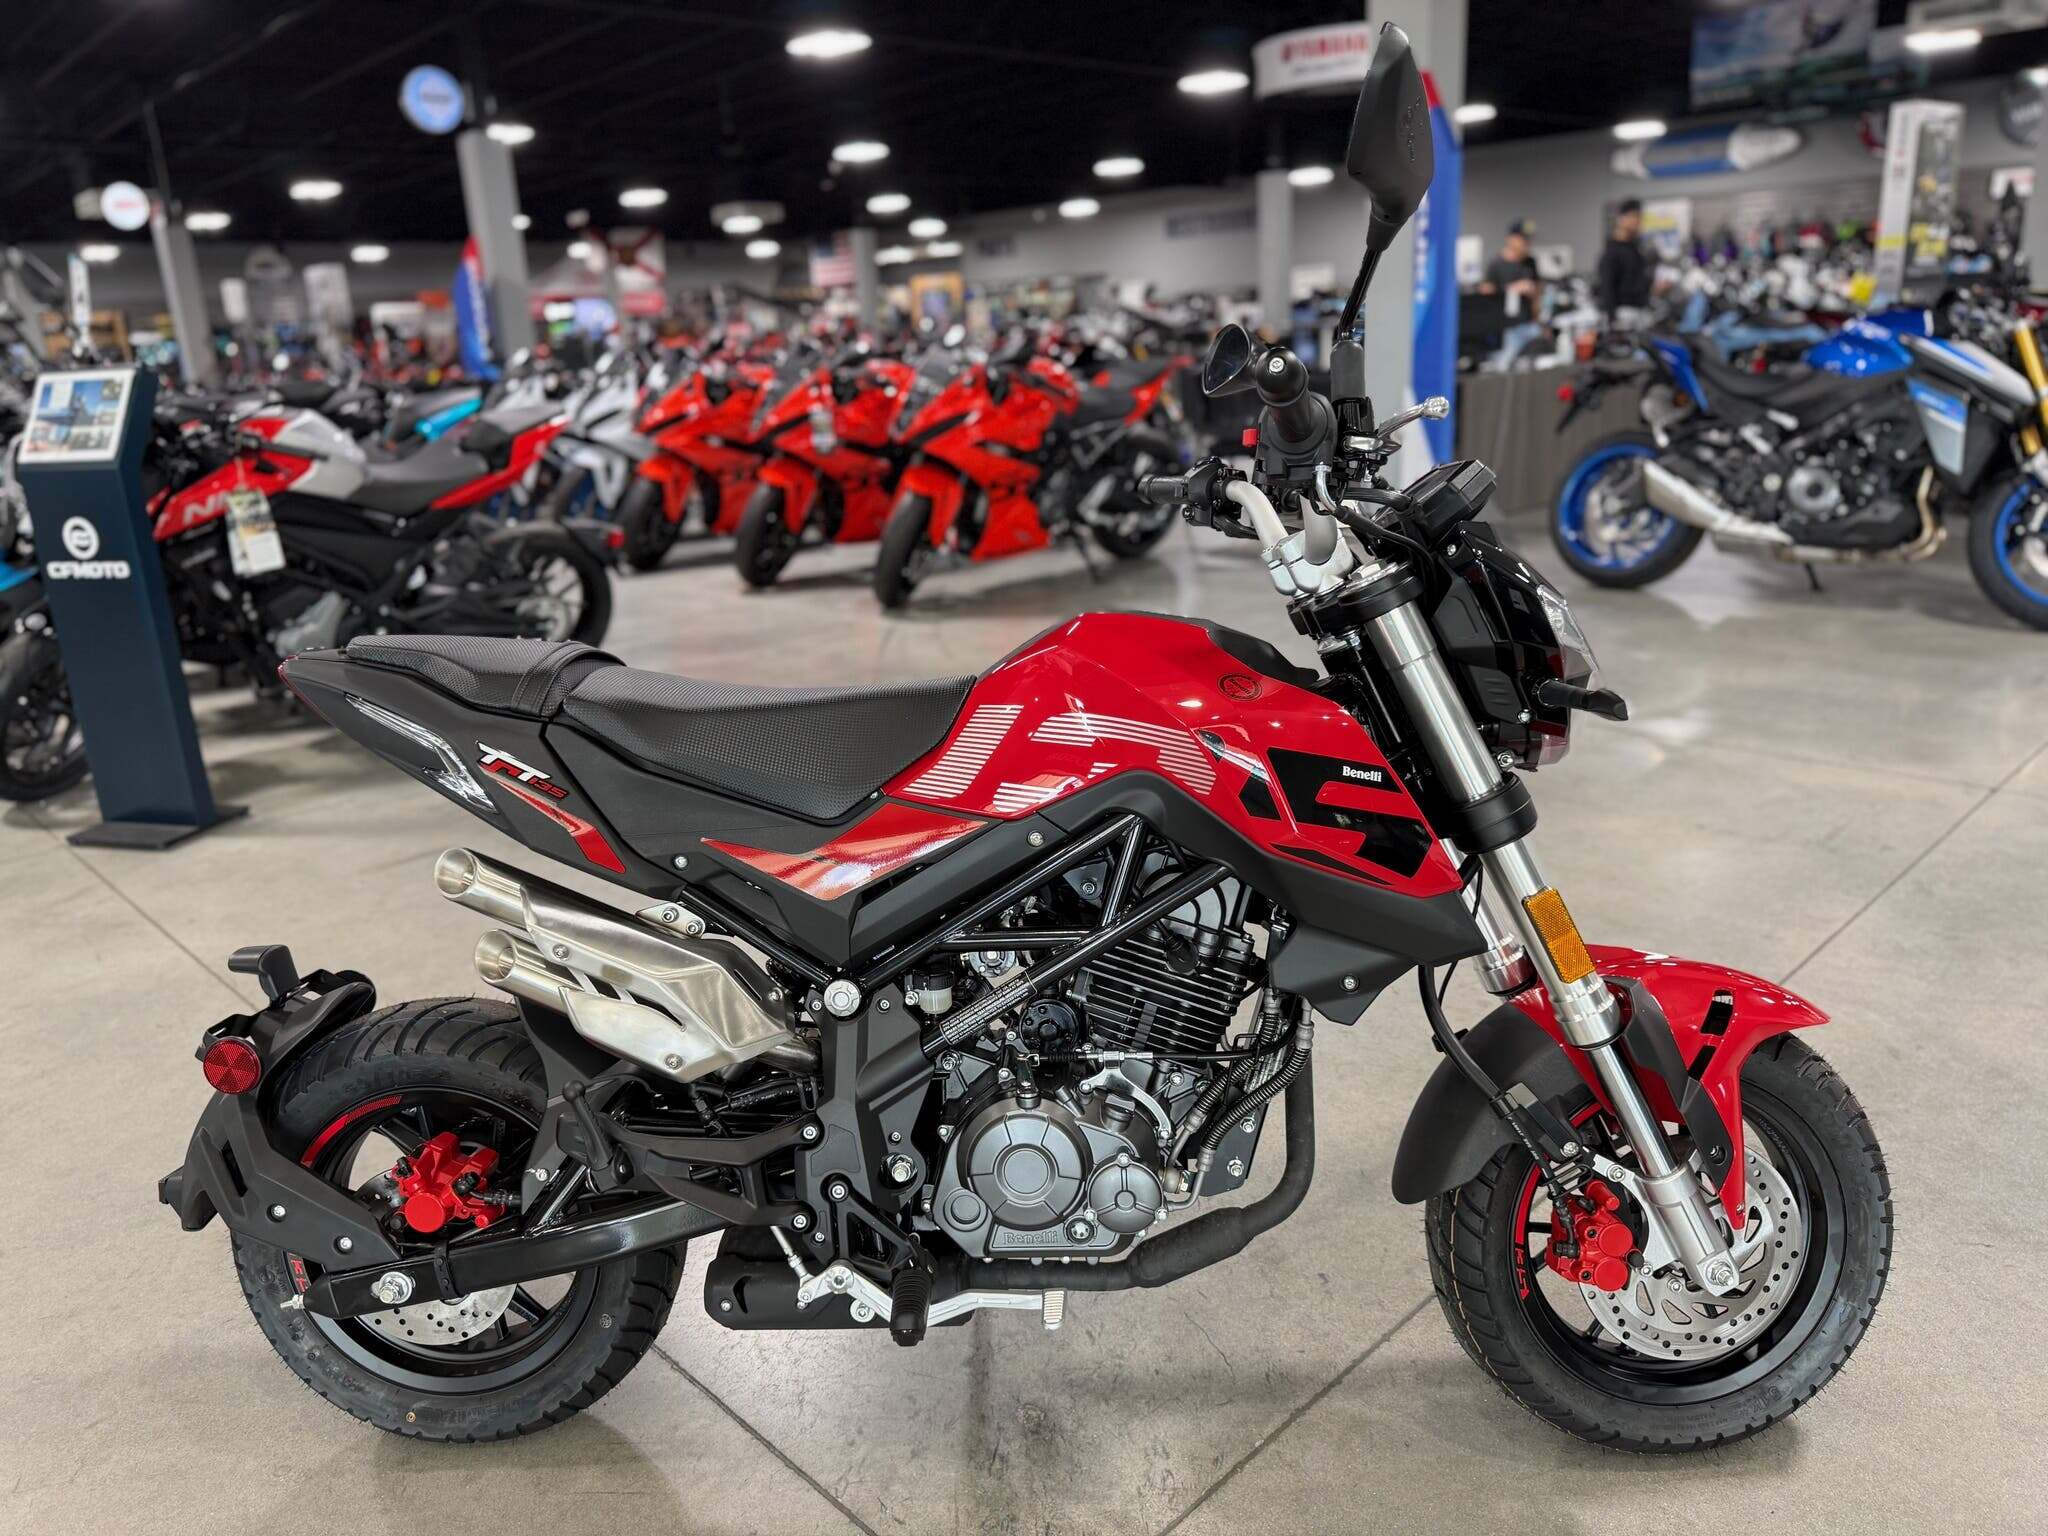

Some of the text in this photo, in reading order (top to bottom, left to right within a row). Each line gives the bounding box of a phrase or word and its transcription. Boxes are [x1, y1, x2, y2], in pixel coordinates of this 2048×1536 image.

[46, 561, 131, 580] CFMOTO
[1342, 765, 1382, 783] Benelli
[1003, 1230, 1058, 1246] Benelli
